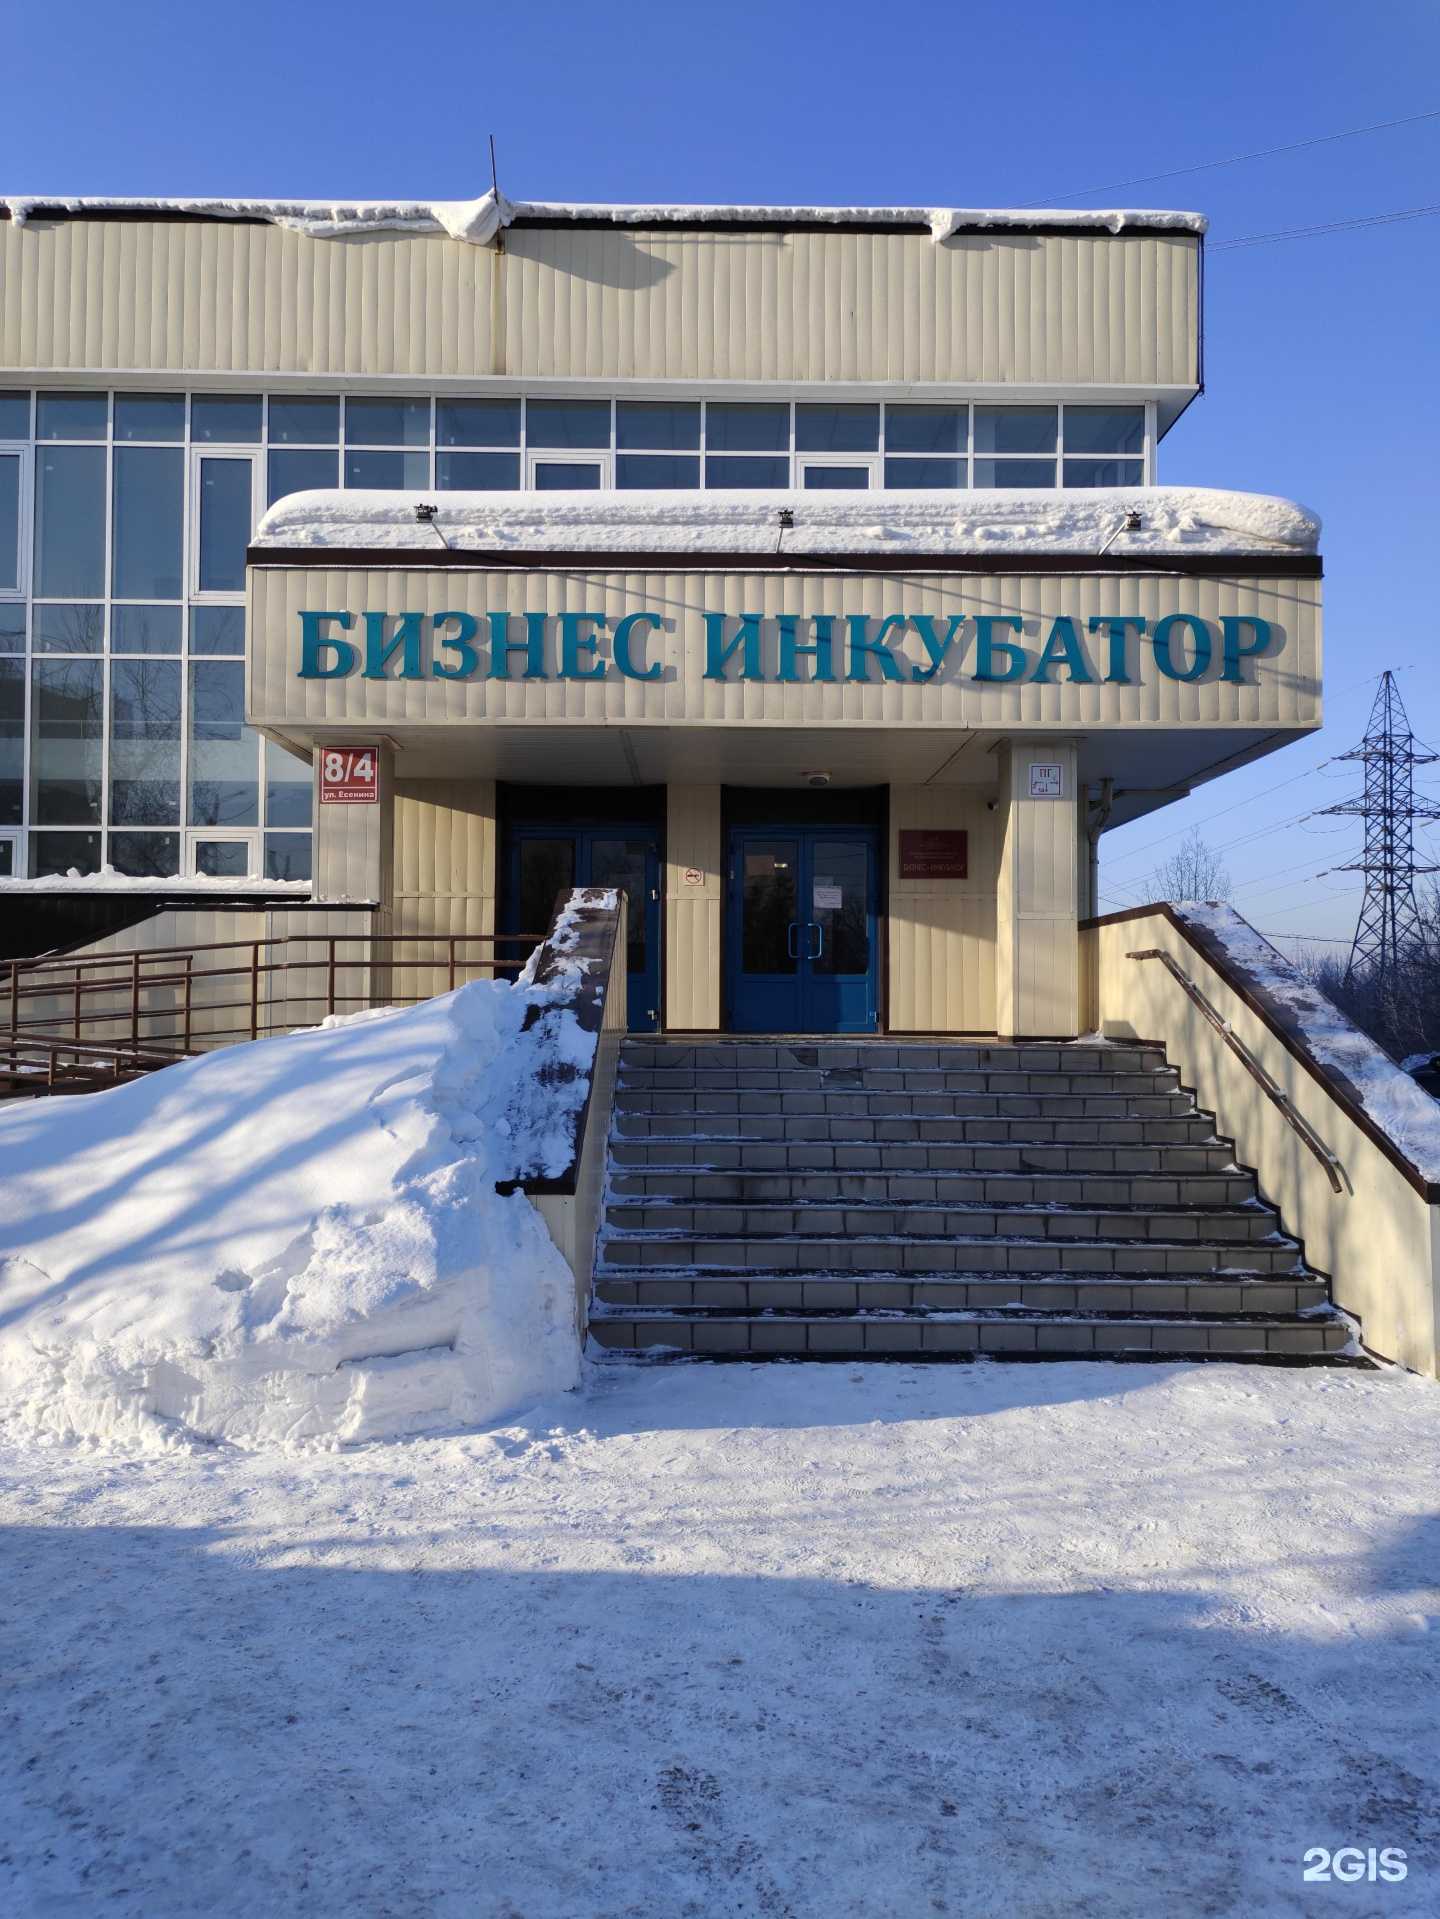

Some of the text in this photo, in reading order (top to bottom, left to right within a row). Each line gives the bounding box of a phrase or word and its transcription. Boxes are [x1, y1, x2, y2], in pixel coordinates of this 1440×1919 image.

[297, 610, 1273, 683] БИЗНЕС ИНКУБАТОР
[325, 752, 374, 782] 8/4
[324, 790, 375, 800] ул. Есенина
